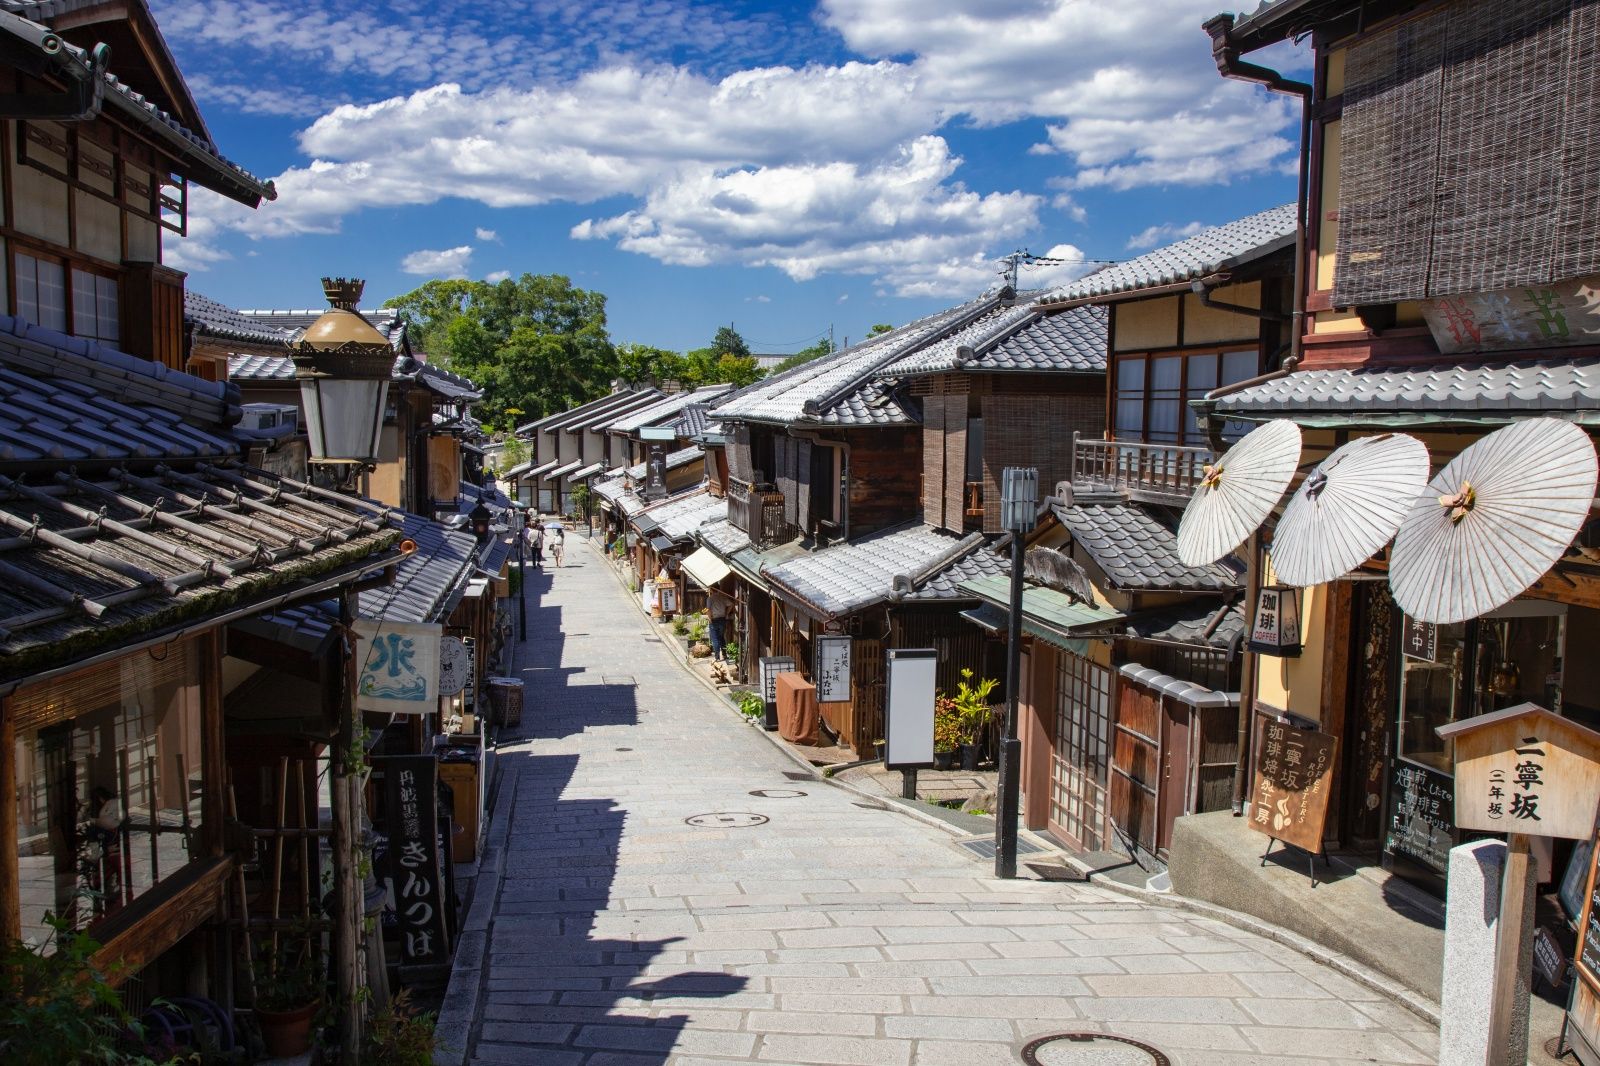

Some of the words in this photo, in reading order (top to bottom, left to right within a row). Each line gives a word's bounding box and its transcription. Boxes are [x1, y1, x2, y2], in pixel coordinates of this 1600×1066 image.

[1254, 630, 1277, 642] COFFEE
[1259, 593, 1277, 631] 珈琲
[822, 670, 833, 696] ふたば
[1255, 725, 1284, 825] 珈琲焙煎工房
[1281, 732, 1304, 789] 二寧坂
[1312, 748, 1327, 794] COFFEE
[1509, 736, 1546, 821] 二寧坂
[1298, 762, 1316, 824] ROASTERS
[1487, 769, 1506, 820] (二年坂)
[400, 841, 435, 957] きんつば
[1542, 932, 1560, 966] YEBISU
